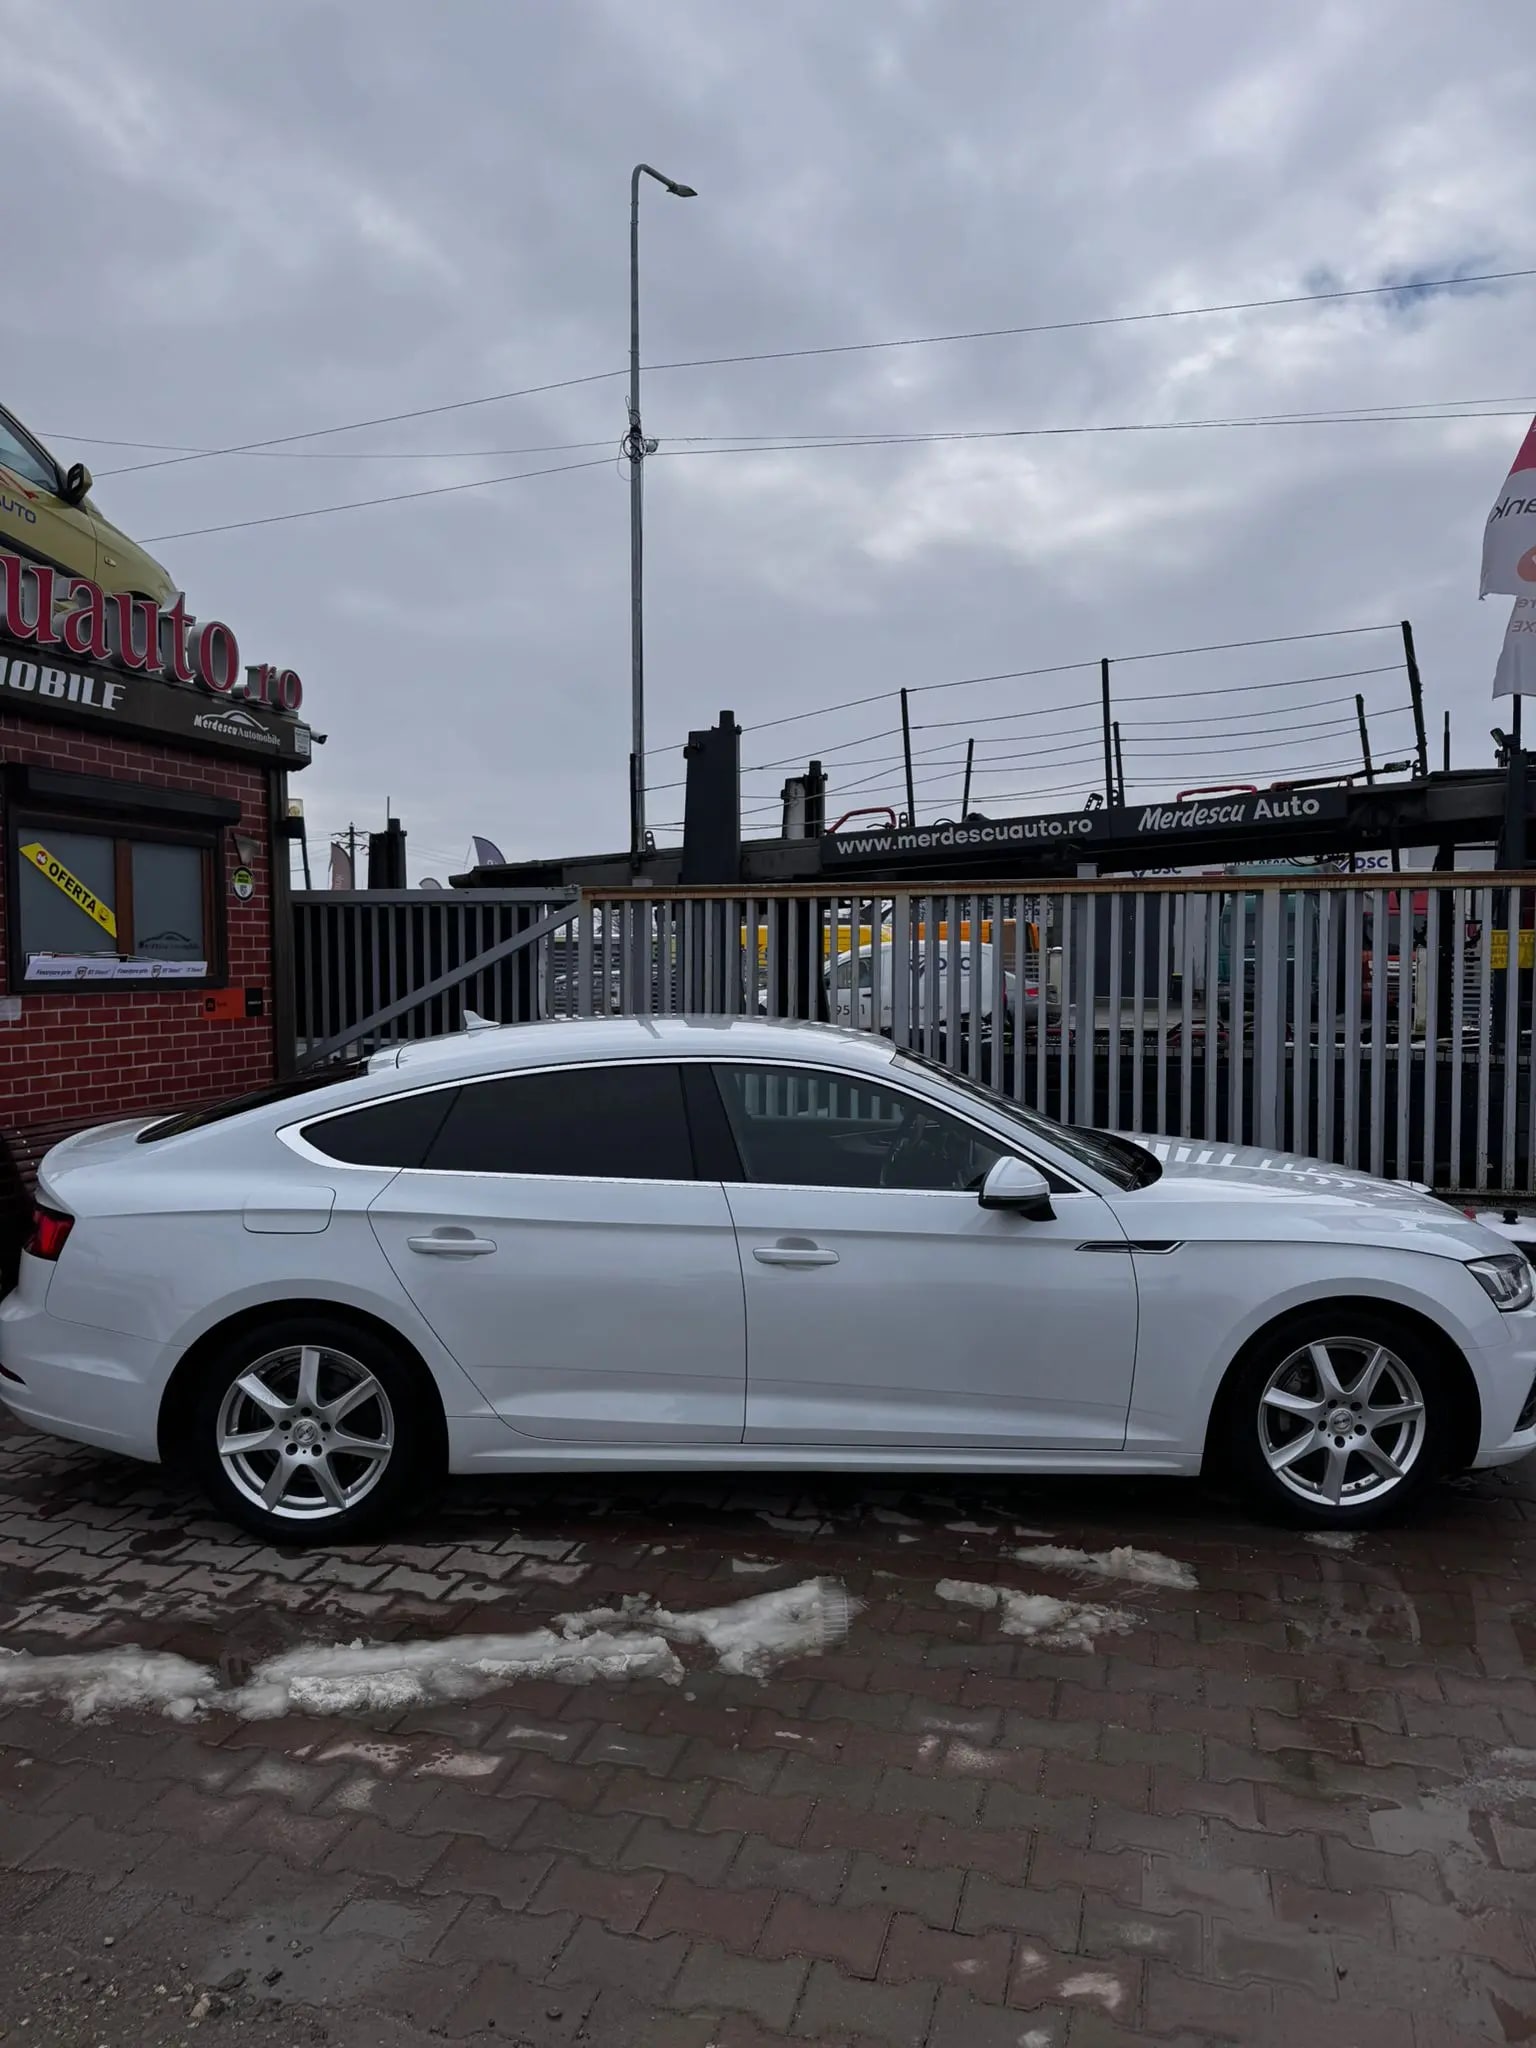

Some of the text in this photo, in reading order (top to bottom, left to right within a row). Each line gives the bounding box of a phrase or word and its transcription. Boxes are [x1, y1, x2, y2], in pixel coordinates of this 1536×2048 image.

[0, 495, 36, 524] UTO
[0, 656, 126, 710] OBILE
[1138, 796, 1320, 832] Merdescu Auto
[837, 817, 1093, 855] www.merdescuauto.ro
[48, 863, 97, 913] OFERTA
